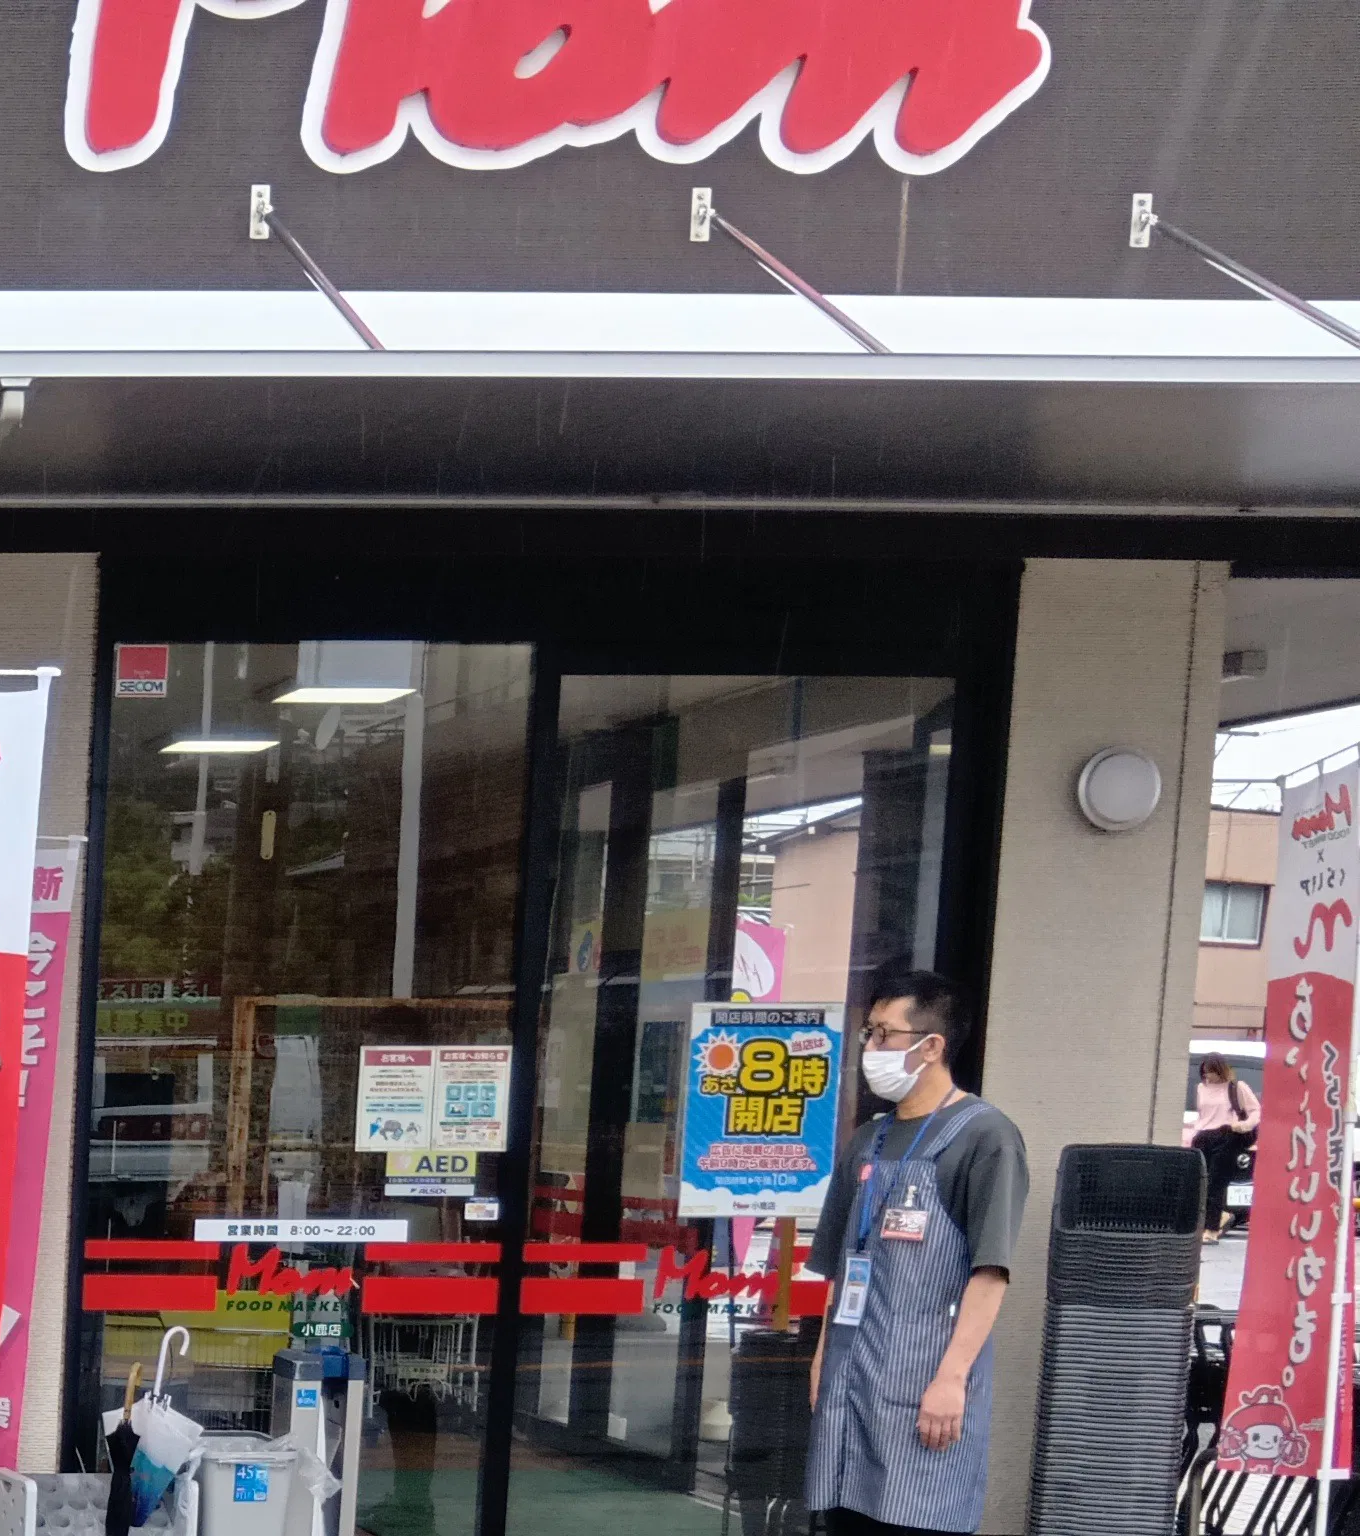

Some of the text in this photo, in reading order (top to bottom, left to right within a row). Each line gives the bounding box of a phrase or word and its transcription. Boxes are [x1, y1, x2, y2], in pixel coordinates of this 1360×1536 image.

[119, 679, 164, 693] SECOM
[791, 1038, 825, 1052] 当店は
[727, 1096, 802, 1134] 開店
[415, 1155, 468, 1173] AED
[227, 1225, 278, 1236] 営業時間
[226, 1301, 273, 1312] FOOD
[301, 1323, 342, 1336] 小鹿店
